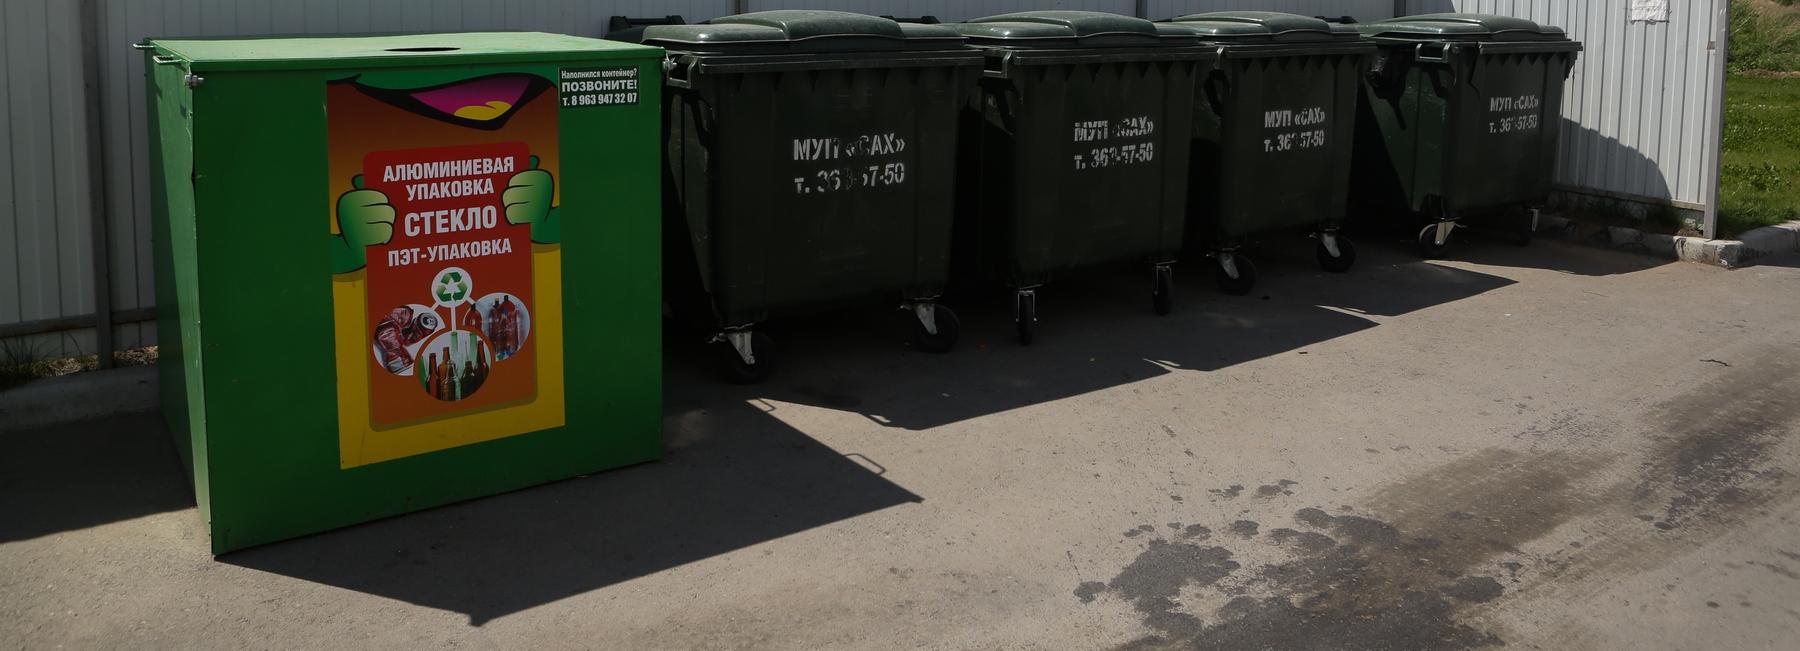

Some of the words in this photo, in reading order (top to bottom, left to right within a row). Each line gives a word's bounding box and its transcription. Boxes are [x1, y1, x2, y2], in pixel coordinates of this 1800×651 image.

[562, 70, 600, 79] Наполнился
[601, 68, 637, 79] контейнер?
[562, 80, 637, 92] ПОЗВОНИТЕ!
[562, 97, 570, 106] т.
[571, 95, 577, 106] 8
[579, 94, 596, 105] 963
[598, 93, 613, 104] 947
[614, 93, 626, 103] 32
[627, 92, 637, 103] 07
[1490, 97, 1512, 111] МУП
[1264, 110, 1291, 128] МУП
[1294, 107, 1325, 125] «САХ»
[1500, 114, 1538, 133] 36-57-50
[1074, 120, 1108, 141] МУП
[793, 138, 839, 160] МУП
[383, 156, 514, 182] АЛЮМИНИЕВАЯ
[406, 178, 494, 201] УПАКОВКА
[794, 177, 810, 193] т.
[404, 205, 497, 237] СТЕКЛО
[388, 238, 512, 267] ПЭТ-УПАКОВКА
